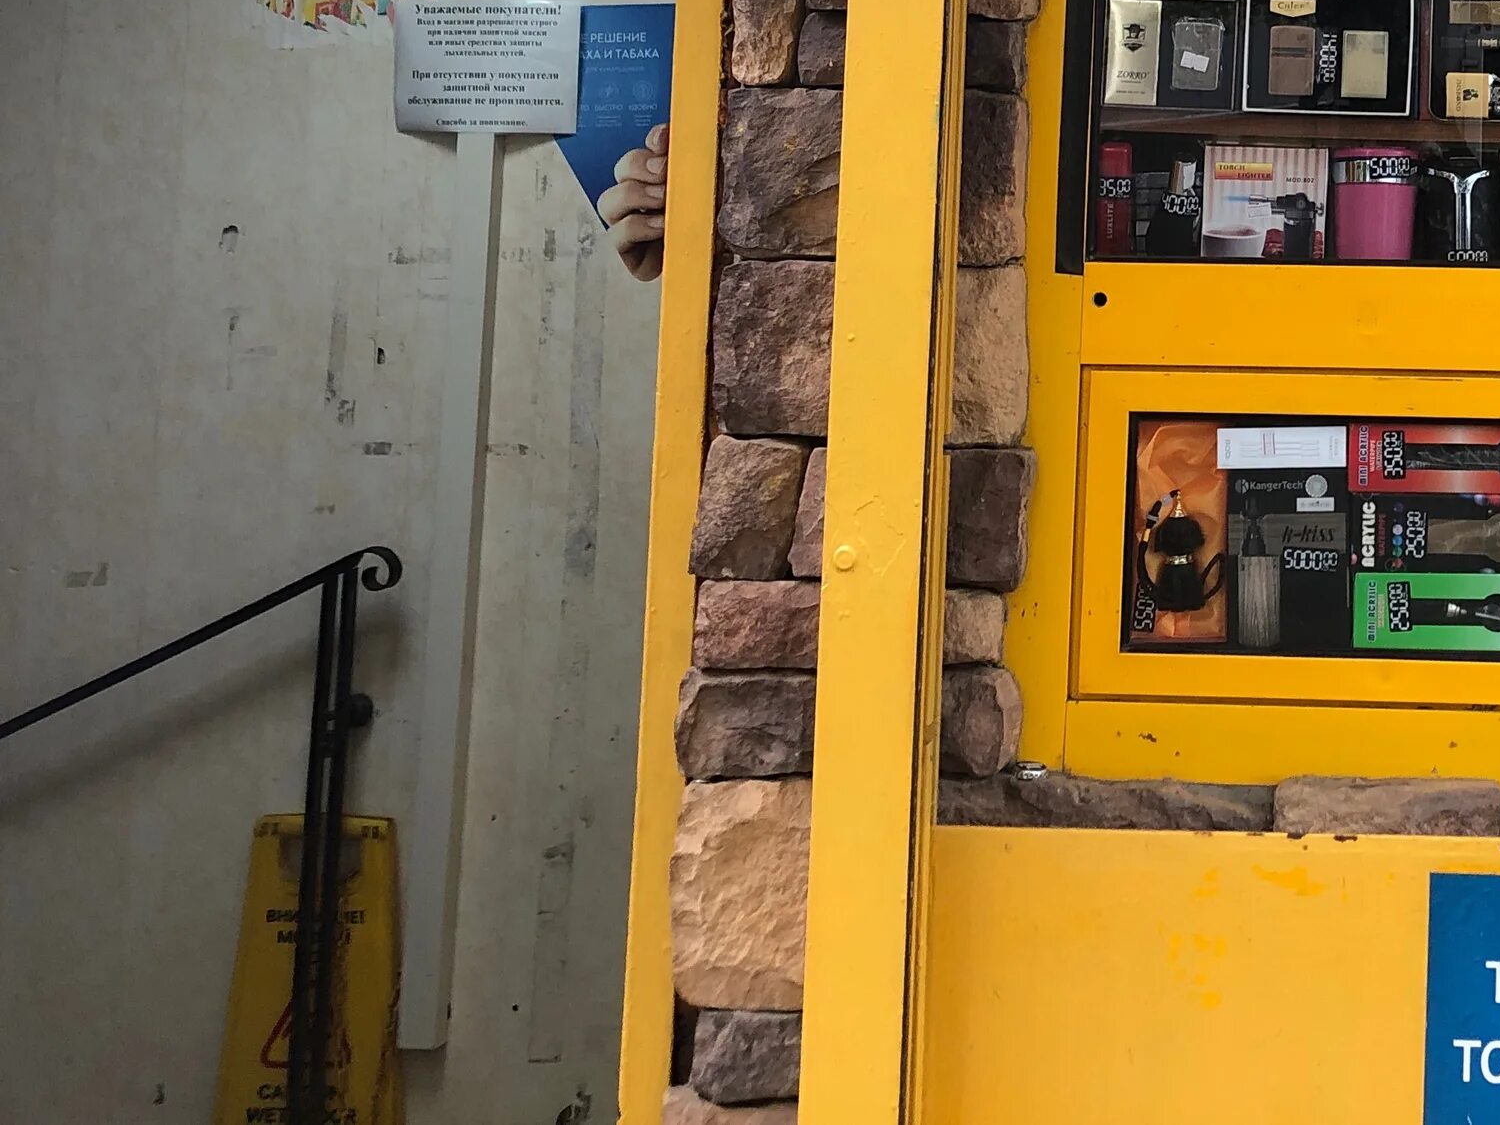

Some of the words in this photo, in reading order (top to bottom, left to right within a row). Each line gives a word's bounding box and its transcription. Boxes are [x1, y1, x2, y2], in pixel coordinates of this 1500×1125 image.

[415, 4, 481, 14] Уважаемые
[485, 5, 561, 16] покупатели!
[590, 32, 647, 44] РЕШЕНИЕ
[604, 49, 613, 59] И
[615, 47, 660, 59] ТАБАКА
[412, 70, 431, 81] При
[433, 72, 487, 81] отсутствии
[1116, 70, 1147, 79] ZORRO
[407, 96, 472, 107] обслуживание
[1369, 158, 1410, 177] 50000
[1358, 426, 1369, 462] ACRYLIC
[1384, 432, 1404, 477] 35000
[1358, 465, 1369, 485] MINI
[1249, 479, 1304, 492] KangerTech
[1361, 501, 1377, 568] ACRYLIC
[1405, 511, 1426, 559] 25000
[1284, 549, 1338, 571] 500000
[1368, 581, 1377, 619] ACRYLIC
[1388, 583, 1410, 630] 25000
